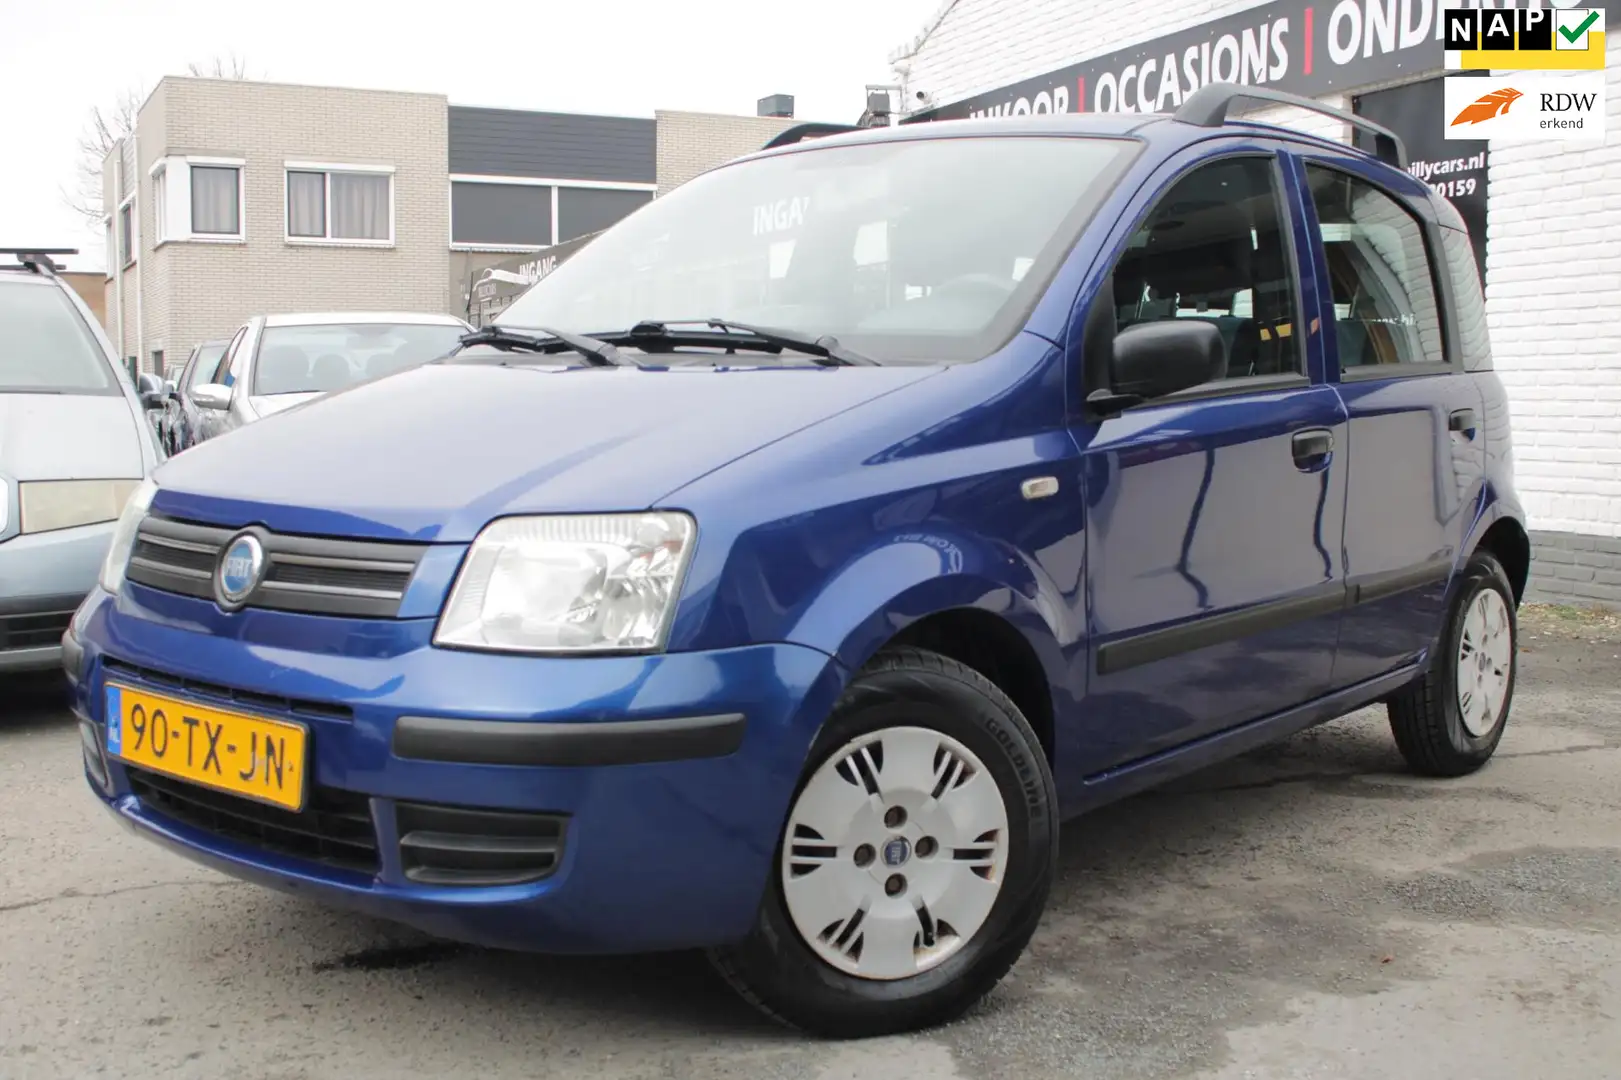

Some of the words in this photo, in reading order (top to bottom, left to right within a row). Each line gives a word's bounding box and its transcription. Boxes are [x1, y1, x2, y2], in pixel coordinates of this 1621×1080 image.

[970, 86, 1069, 119] OOP
[1094, 17, 1289, 114] OCCASIONS
[752, 196, 810, 236] INGA
[225, 557, 253, 577] FIAT
[131, 703, 285, 790] 90-TX-JN
